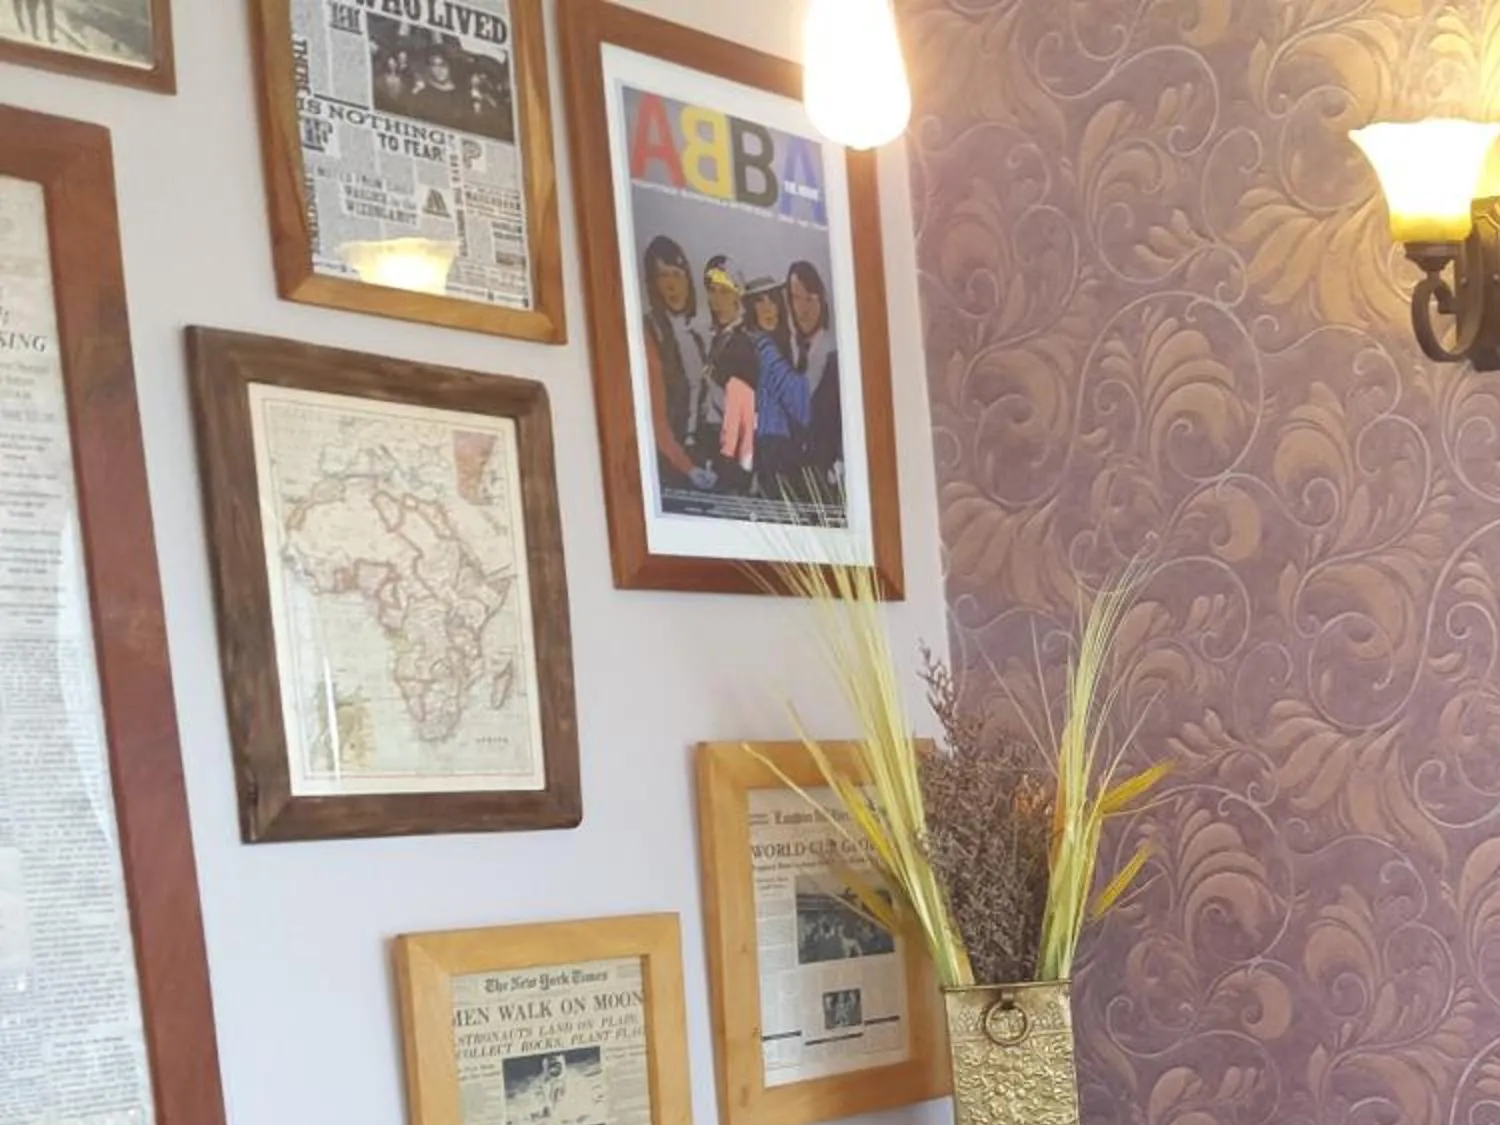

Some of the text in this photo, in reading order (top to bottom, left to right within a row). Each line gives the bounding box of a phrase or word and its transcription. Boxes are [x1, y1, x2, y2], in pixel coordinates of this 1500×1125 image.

[426, 0, 508, 45] LIVED
[377, 132, 399, 151] TO
[630, 93, 828, 227] ABBA
[484, 968, 609, 993] The New York Times
[498, 1000, 554, 1021] WALK
[560, 994, 587, 1016] ON
